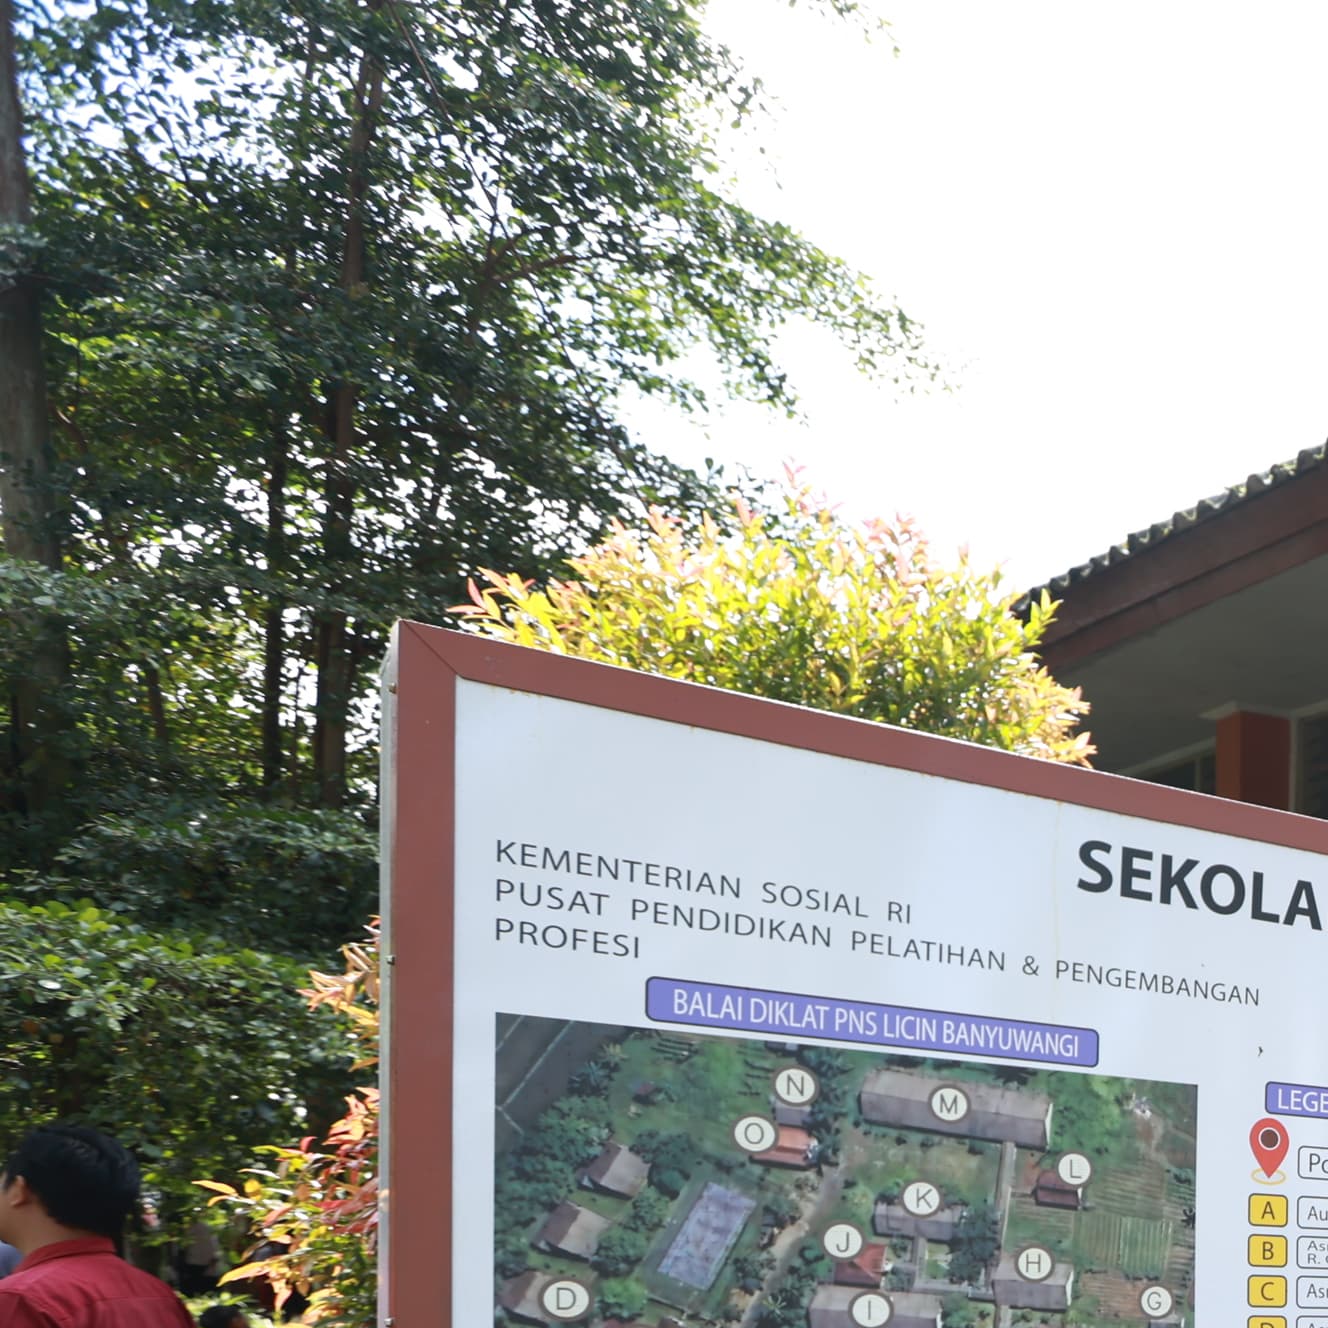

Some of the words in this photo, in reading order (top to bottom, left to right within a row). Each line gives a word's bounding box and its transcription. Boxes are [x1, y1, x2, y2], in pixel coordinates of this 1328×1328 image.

[496, 839, 741, 899] KEMENTERIAN
[762, 882, 869, 918] SOSIAL
[888, 901, 911, 924] RI
[496, 917, 640, 958] PROFESI
[496, 879, 610, 916] PUSAT
[631, 899, 831, 947] PENDIDIKAN
[851, 930, 1005, 971] PELATIHAN
[1022, 955, 1039, 976] &
[1056, 960, 1259, 1006] PENGEMBANGAN
[673, 988, 742, 1021] BALAI
[750, 997, 829, 1031] DIKLAT
[835, 1008, 877, 1036] PNS
[884, 1014, 936, 1042] LICIN
[943, 1021, 1079, 1058] BANYUWANGI
[786, 1075, 804, 1096] N
[940, 1094, 958, 1114] M
[744, 1122, 765, 1145] O
[1069, 1159, 1082, 1179] L
[916, 1189, 933, 1208] K
[1261, 1201, 1275, 1220] A
[836, 1232, 850, 1254] J
[1262, 1241, 1274, 1260] B
[1026, 1254, 1042, 1273] H
[1307, 1254, 1320, 1264] R.
[556, 1287, 576, 1310] D
[1149, 1291, 1162, 1311] G
[1261, 1282, 1274, 1301] C
